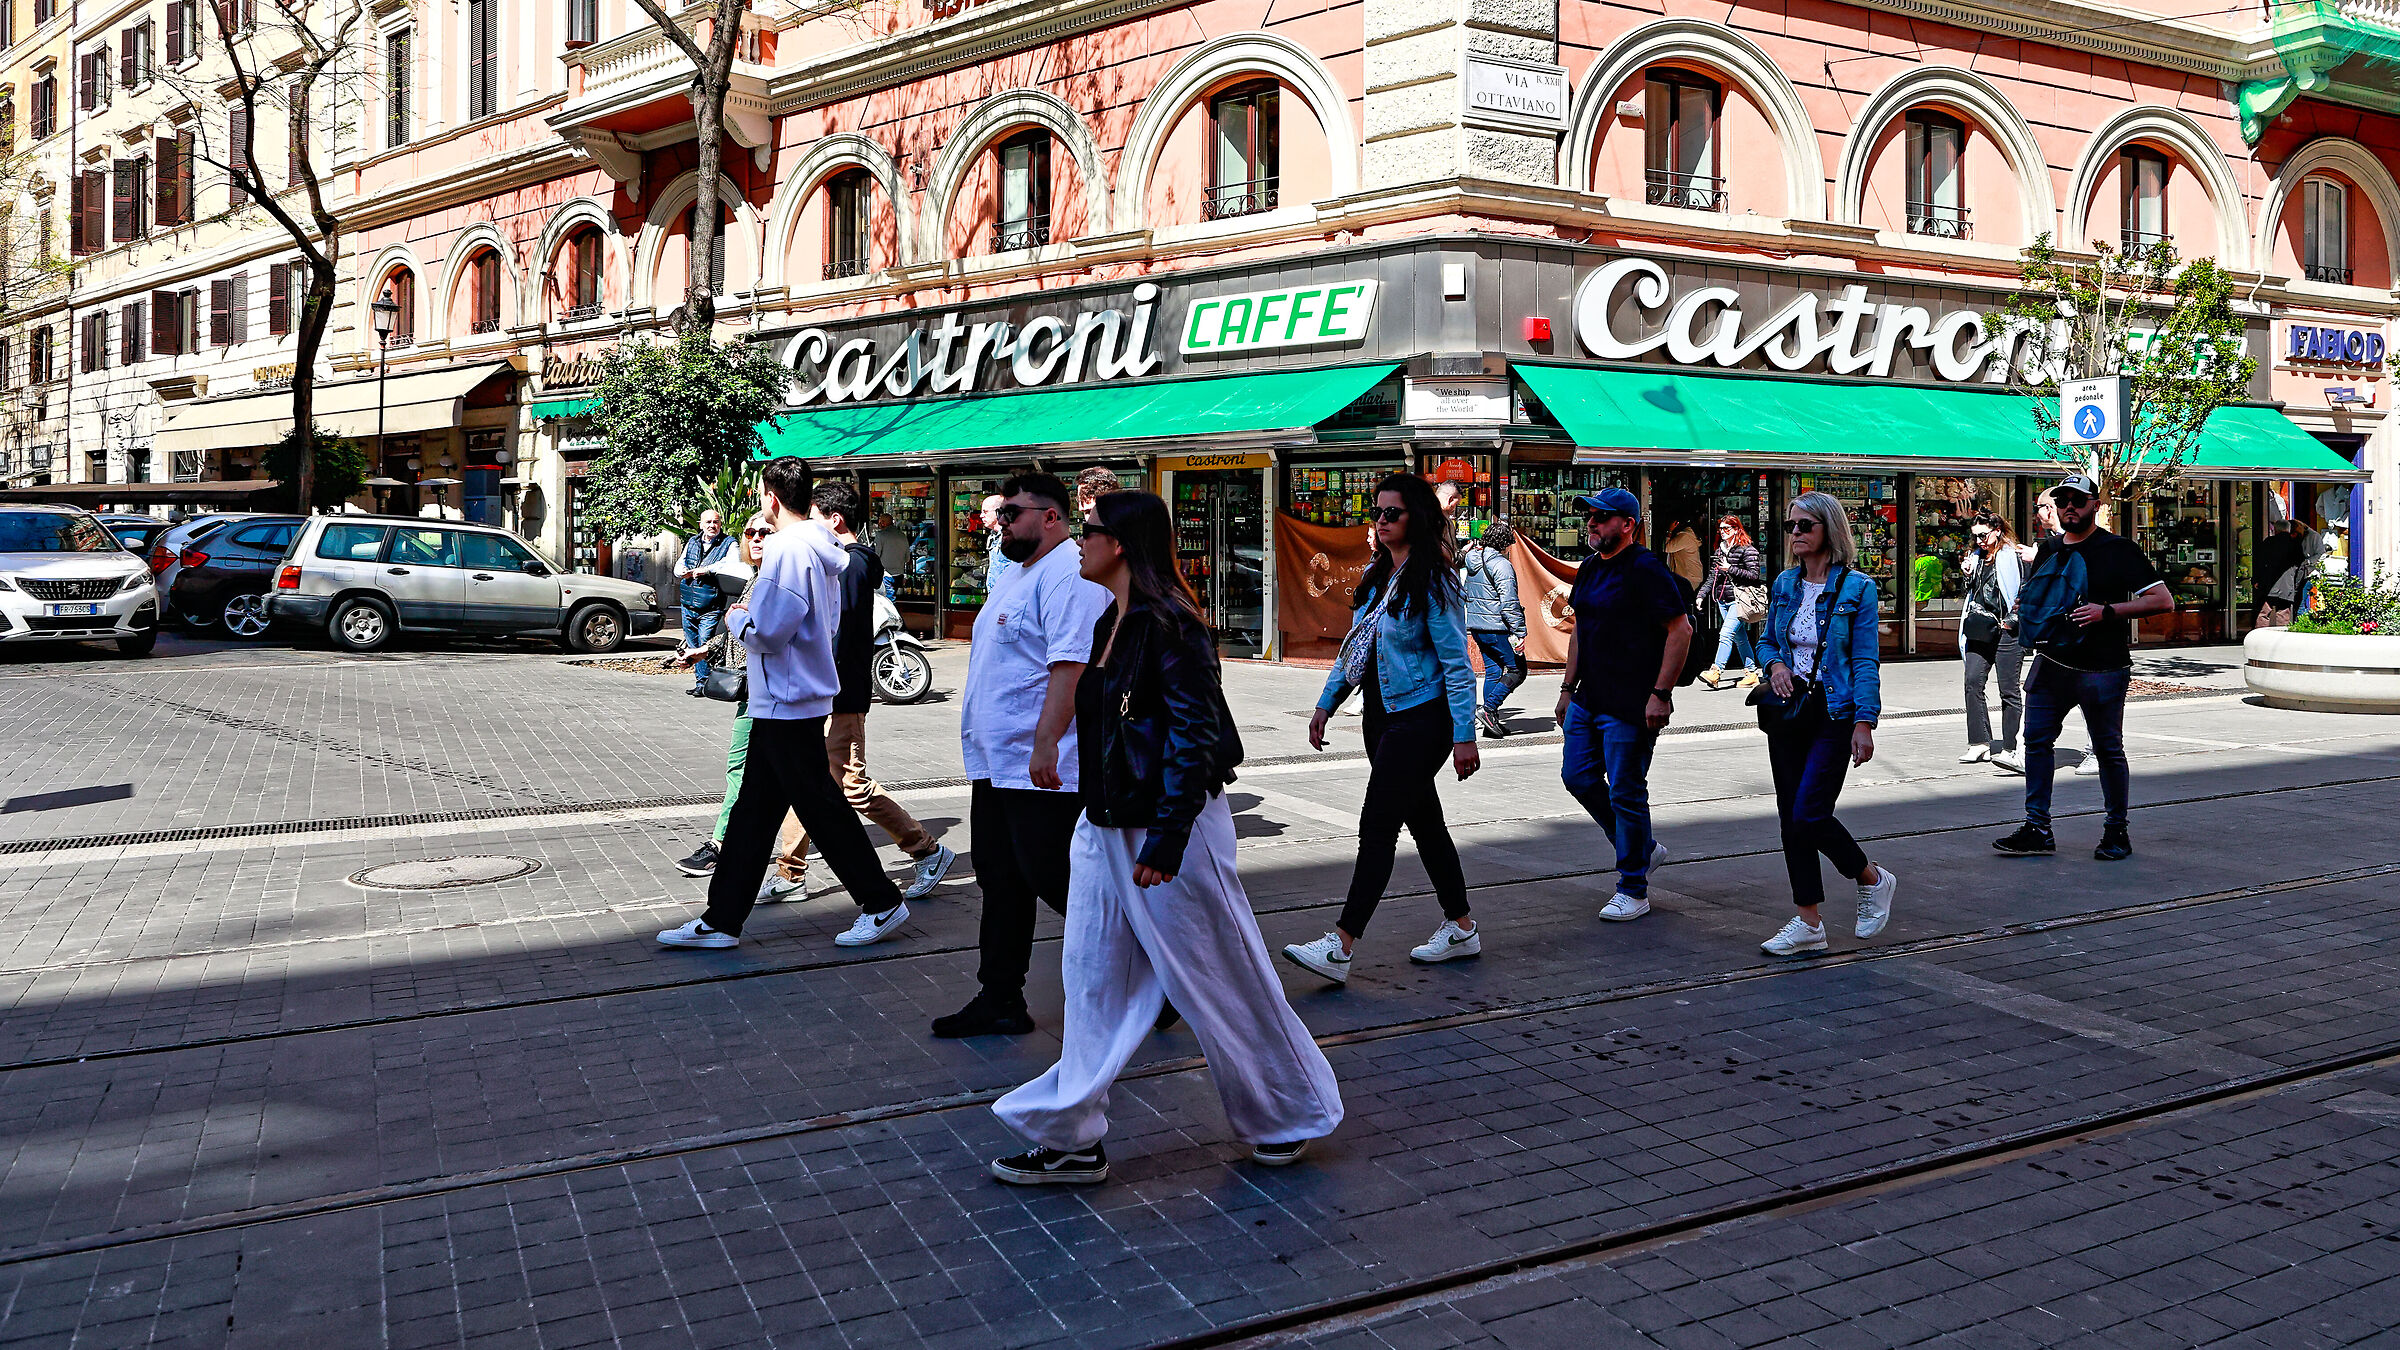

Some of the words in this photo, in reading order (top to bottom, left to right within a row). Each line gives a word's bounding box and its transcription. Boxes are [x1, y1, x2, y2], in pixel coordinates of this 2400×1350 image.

[1505, 72, 1528, 88] VIA
[1476, 91, 1556, 114] OTTAVIANO
[1574, 257, 2080, 388] Castroni
[781, 282, 1162, 406] Castroni
[1453, 388, 1471, 397] ship
[2074, 392, 2104, 403] pedonale
[1436, 405, 1449, 413] the
[1186, 452, 1246, 467] Castroni
